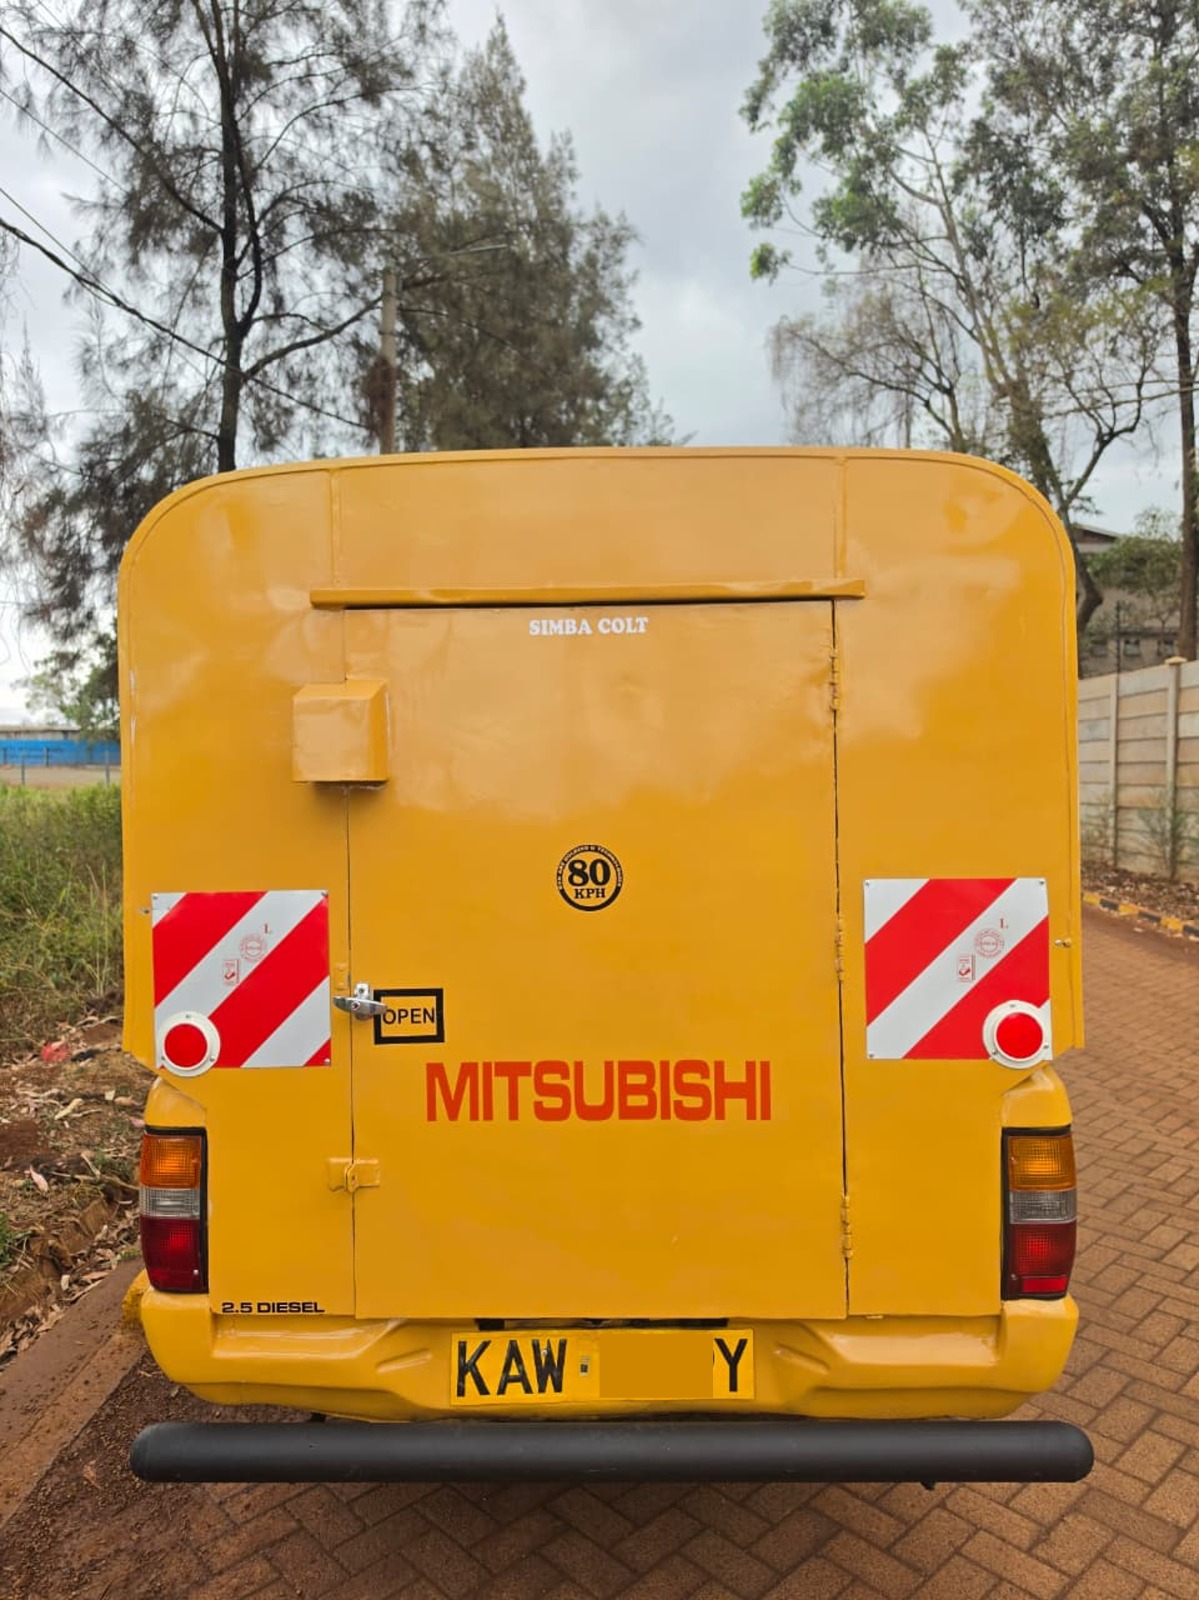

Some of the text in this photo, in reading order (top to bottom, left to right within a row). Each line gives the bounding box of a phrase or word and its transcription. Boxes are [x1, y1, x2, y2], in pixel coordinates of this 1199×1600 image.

[529, 616, 649, 636] SIMBA COLT
[568, 858, 611, 887] 80
[574, 887, 606, 900] KPH
[383, 1007, 435, 1025] OPEN
[426, 1060, 771, 1121] MITSUBISHI
[222, 1301, 325, 1313] 2.5 DIESEL
[456, 1338, 568, 1397] KAW
